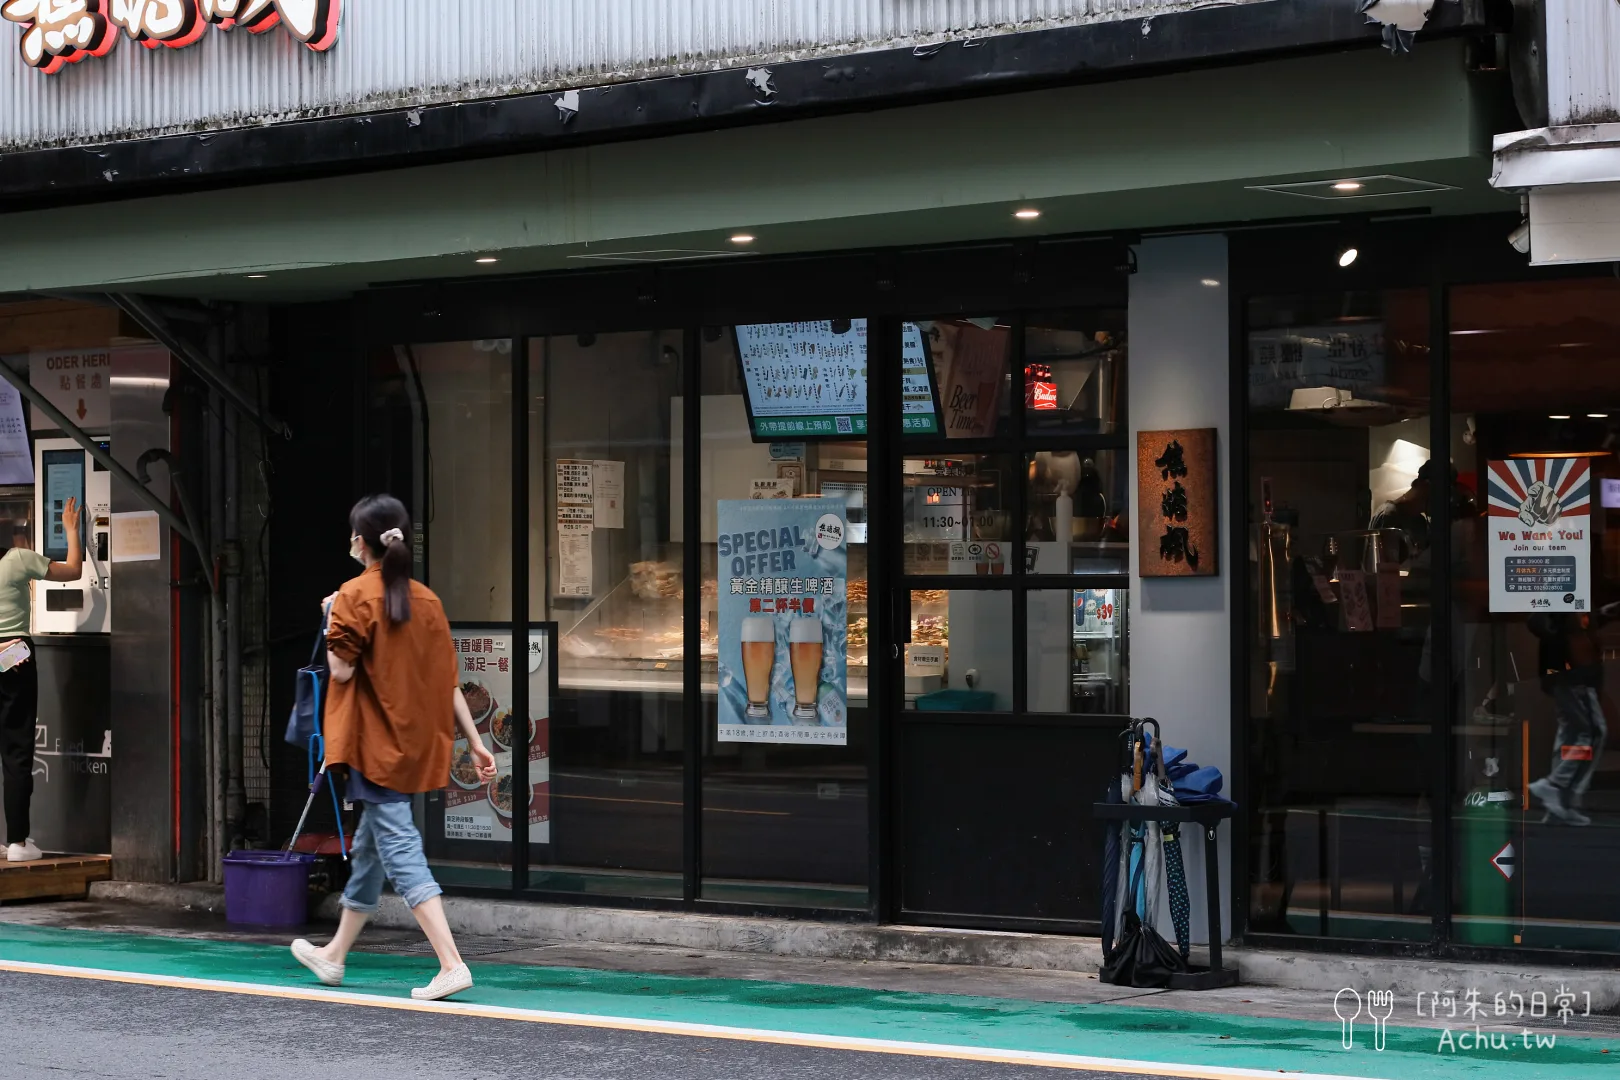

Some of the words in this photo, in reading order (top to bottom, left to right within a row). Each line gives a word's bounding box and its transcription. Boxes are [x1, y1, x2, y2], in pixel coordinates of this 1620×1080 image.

[47, 355, 79, 370] ODER
[59, 372, 102, 391] 點餐處
[948, 384, 978, 410] Beer
[949, 408, 977, 431] Time
[927, 486, 957, 497] OPEN
[718, 525, 806, 557] SPECIAL
[1498, 531, 1516, 541] We
[1522, 530, 1553, 541] Want
[1558, 529, 1584, 540] You!
[731, 550, 796, 577] OFFER
[730, 577, 834, 595] 黃金精釀生啤酒
[749, 597, 815, 614] 第二杯半價
[1096, 603, 1113, 620] $39
[464, 656, 509, 673] 滿足一餐
